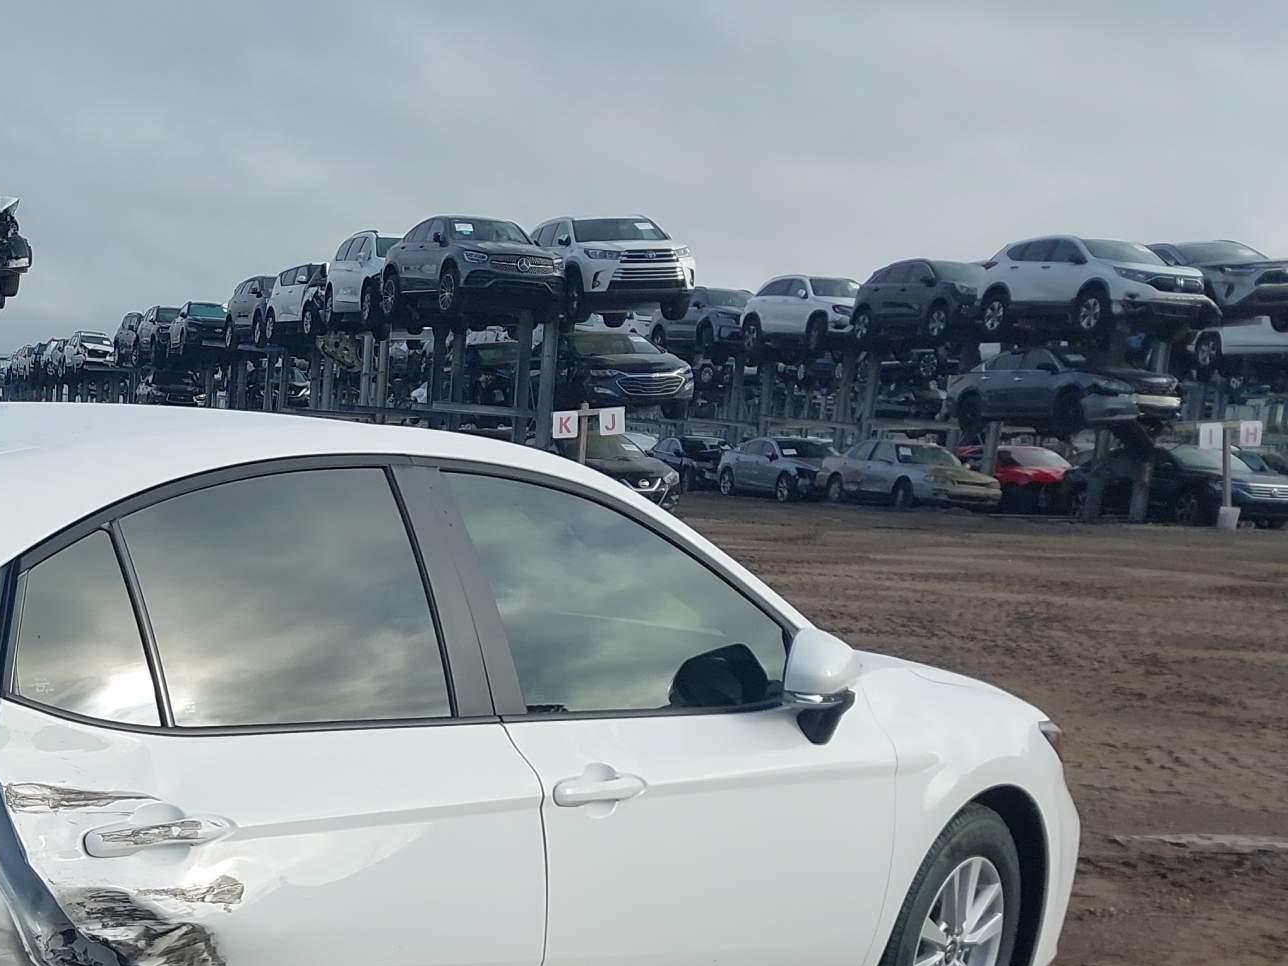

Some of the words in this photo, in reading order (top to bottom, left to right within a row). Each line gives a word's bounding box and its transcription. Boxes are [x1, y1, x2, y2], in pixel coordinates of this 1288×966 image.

[558, 416, 572, 434] K
[604, 413, 616, 431] J
[1245, 426, 1258, 443] H
